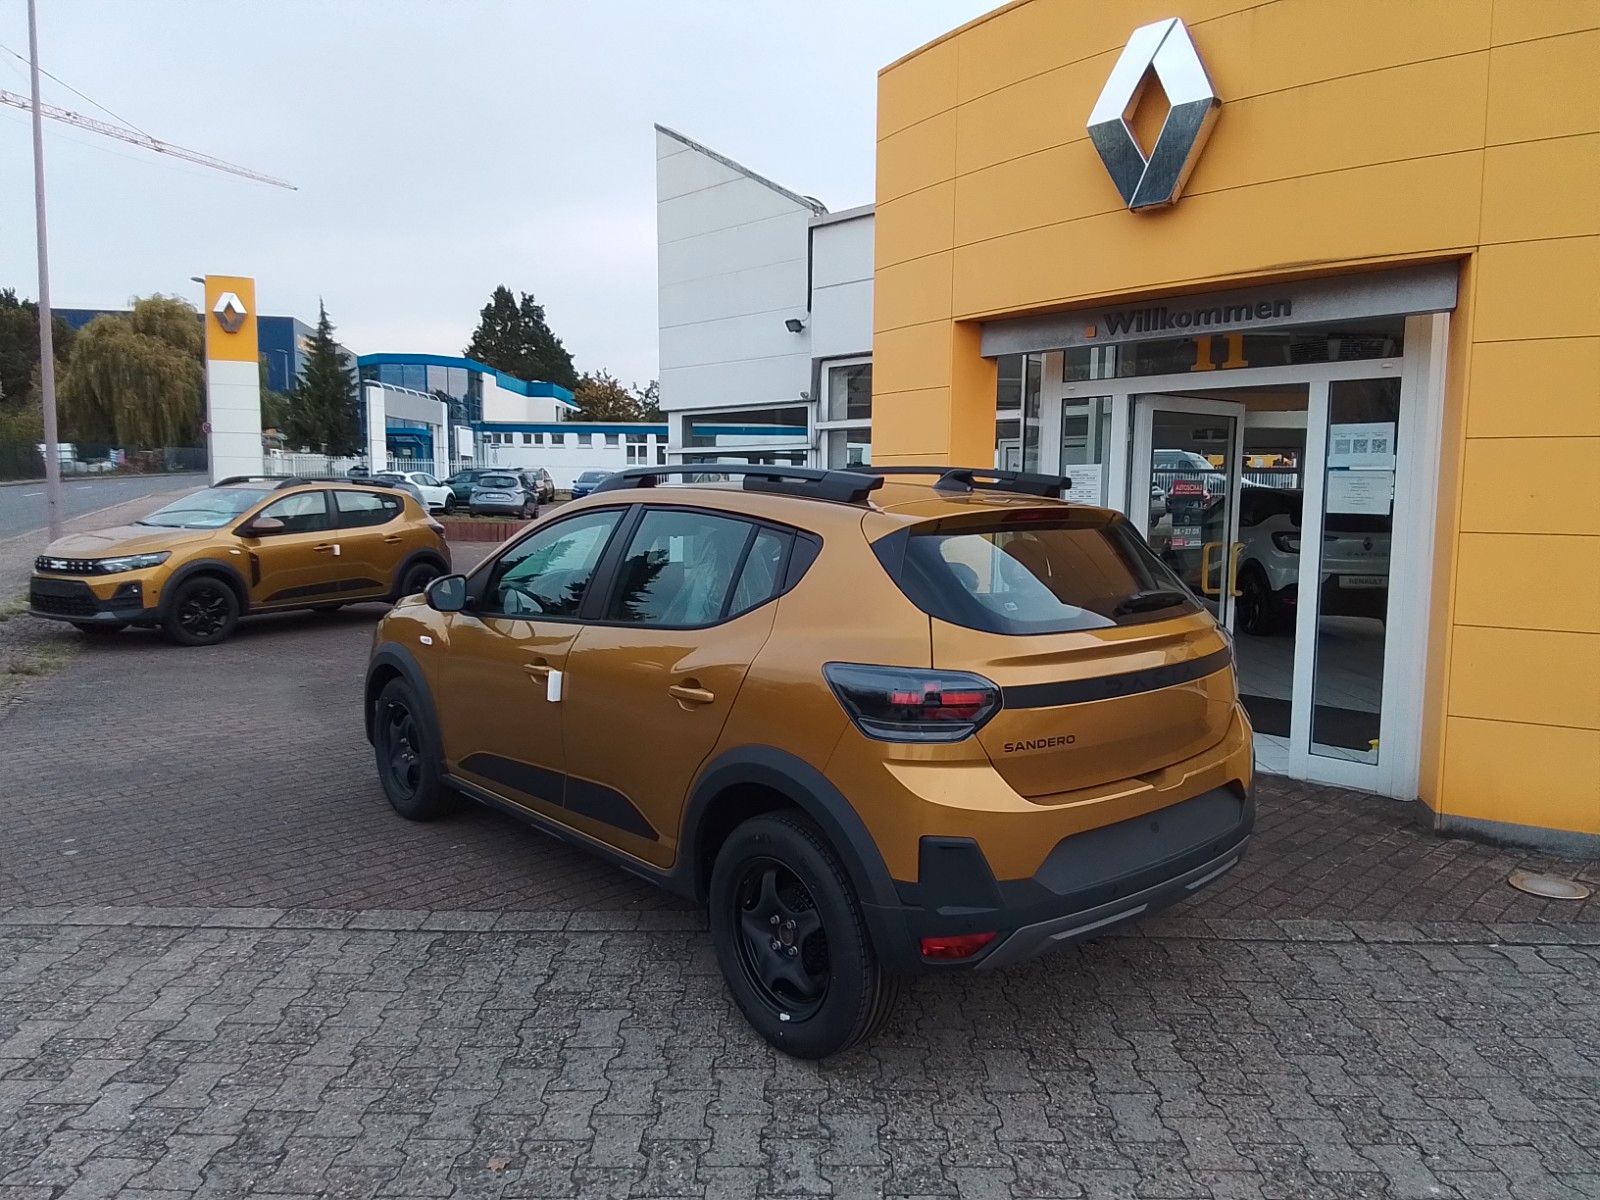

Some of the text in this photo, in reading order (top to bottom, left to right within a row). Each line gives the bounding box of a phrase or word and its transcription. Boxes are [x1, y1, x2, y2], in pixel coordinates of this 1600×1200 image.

[1104, 299, 1292, 335] Willkommen
[1348, 577, 1383, 585] RENAULT
[1004, 735, 1076, 753] SANDERO
